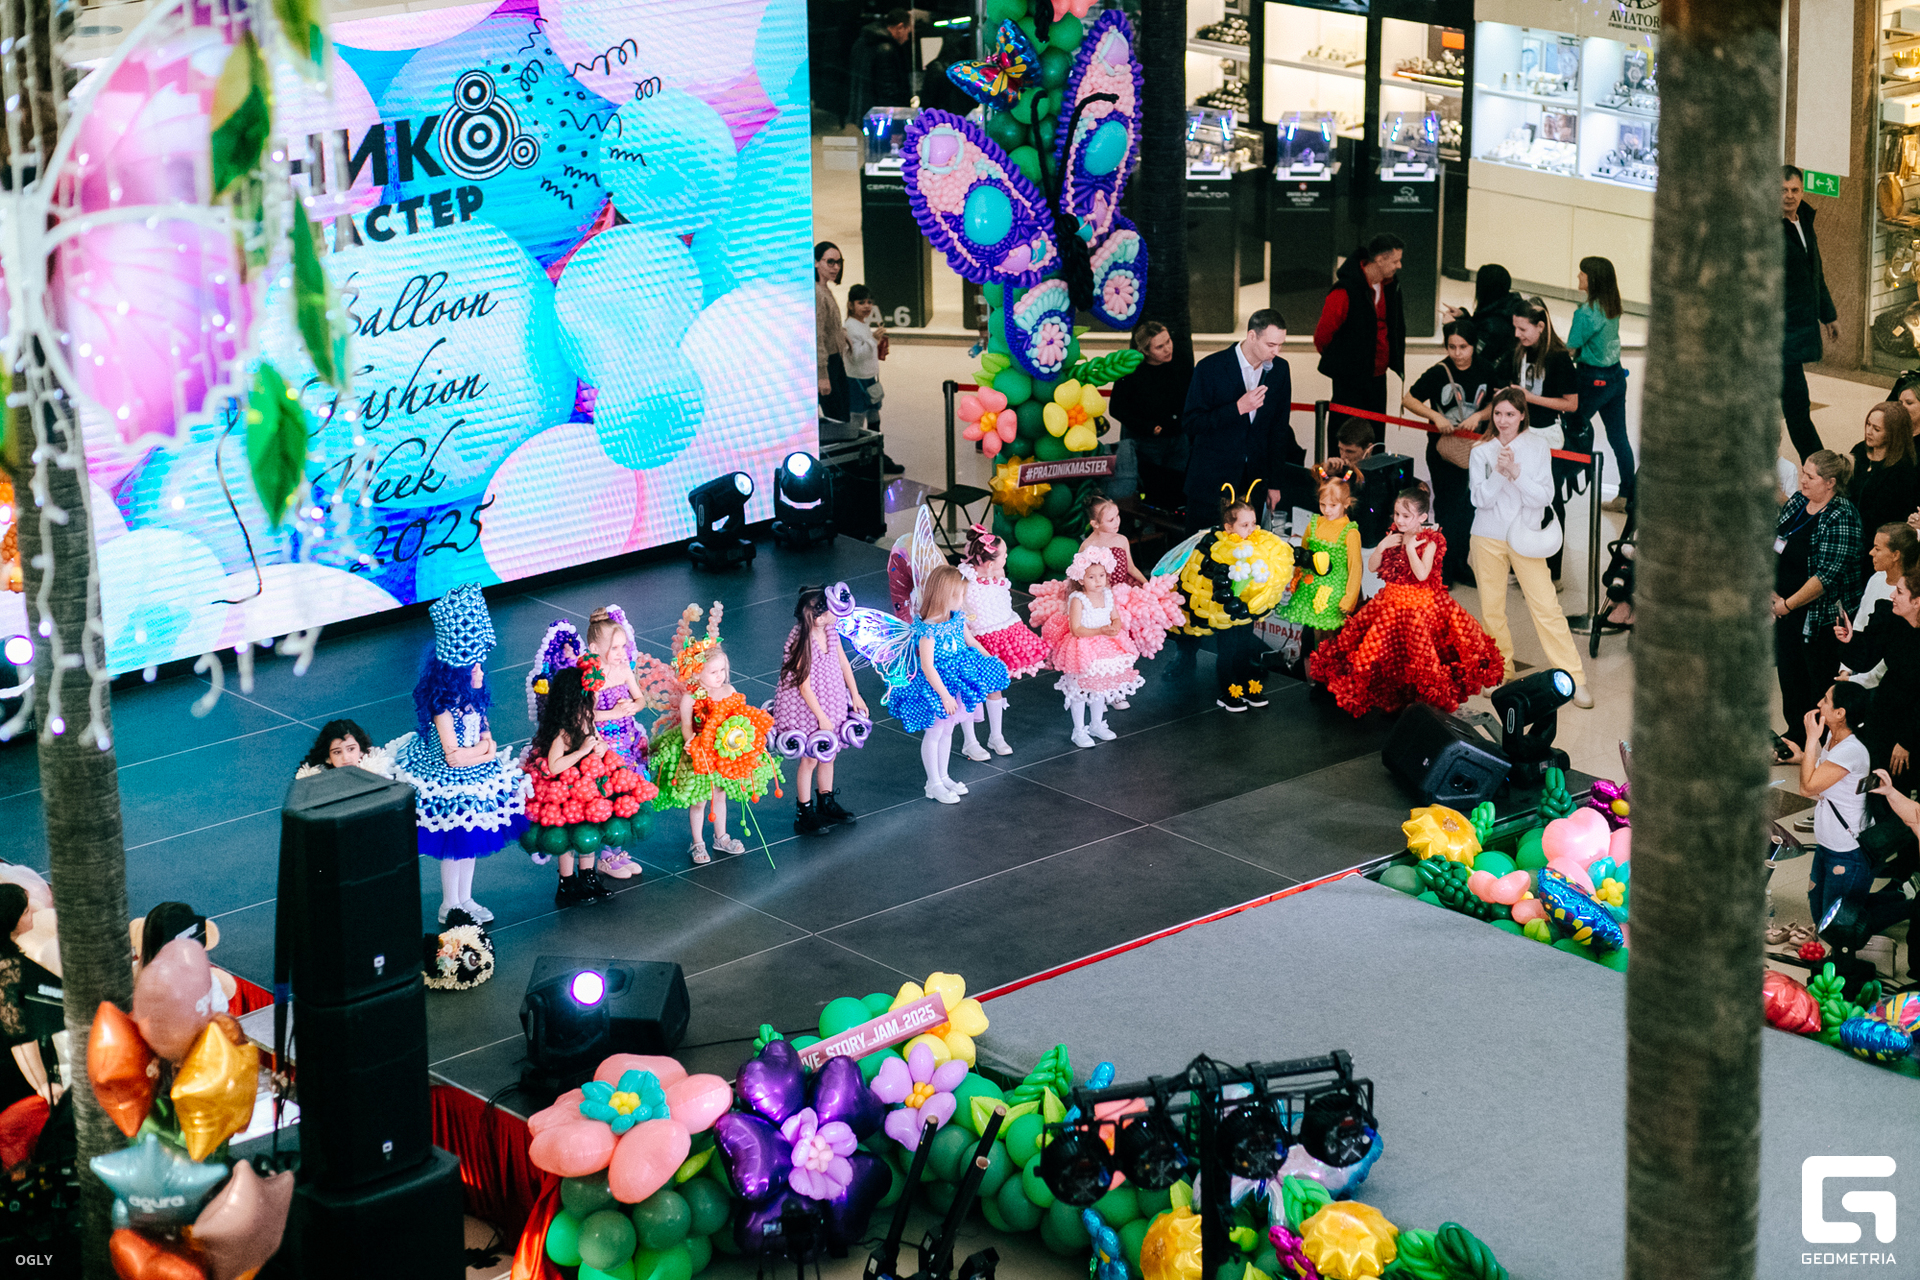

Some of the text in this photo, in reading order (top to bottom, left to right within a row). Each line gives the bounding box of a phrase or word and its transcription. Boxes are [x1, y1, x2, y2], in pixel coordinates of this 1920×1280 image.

[1609, 9, 1660, 28] AVIATOR
[290, 114, 447, 195] НИК
[338, 270, 499, 338] Balloon
[304, 418, 466, 513] Week
[1025, 459, 1108, 481] #PRAZDNIKMASTER
[349, 493, 496, 573] 2025
[1269, 622, 1302, 642] ПРАЗД
